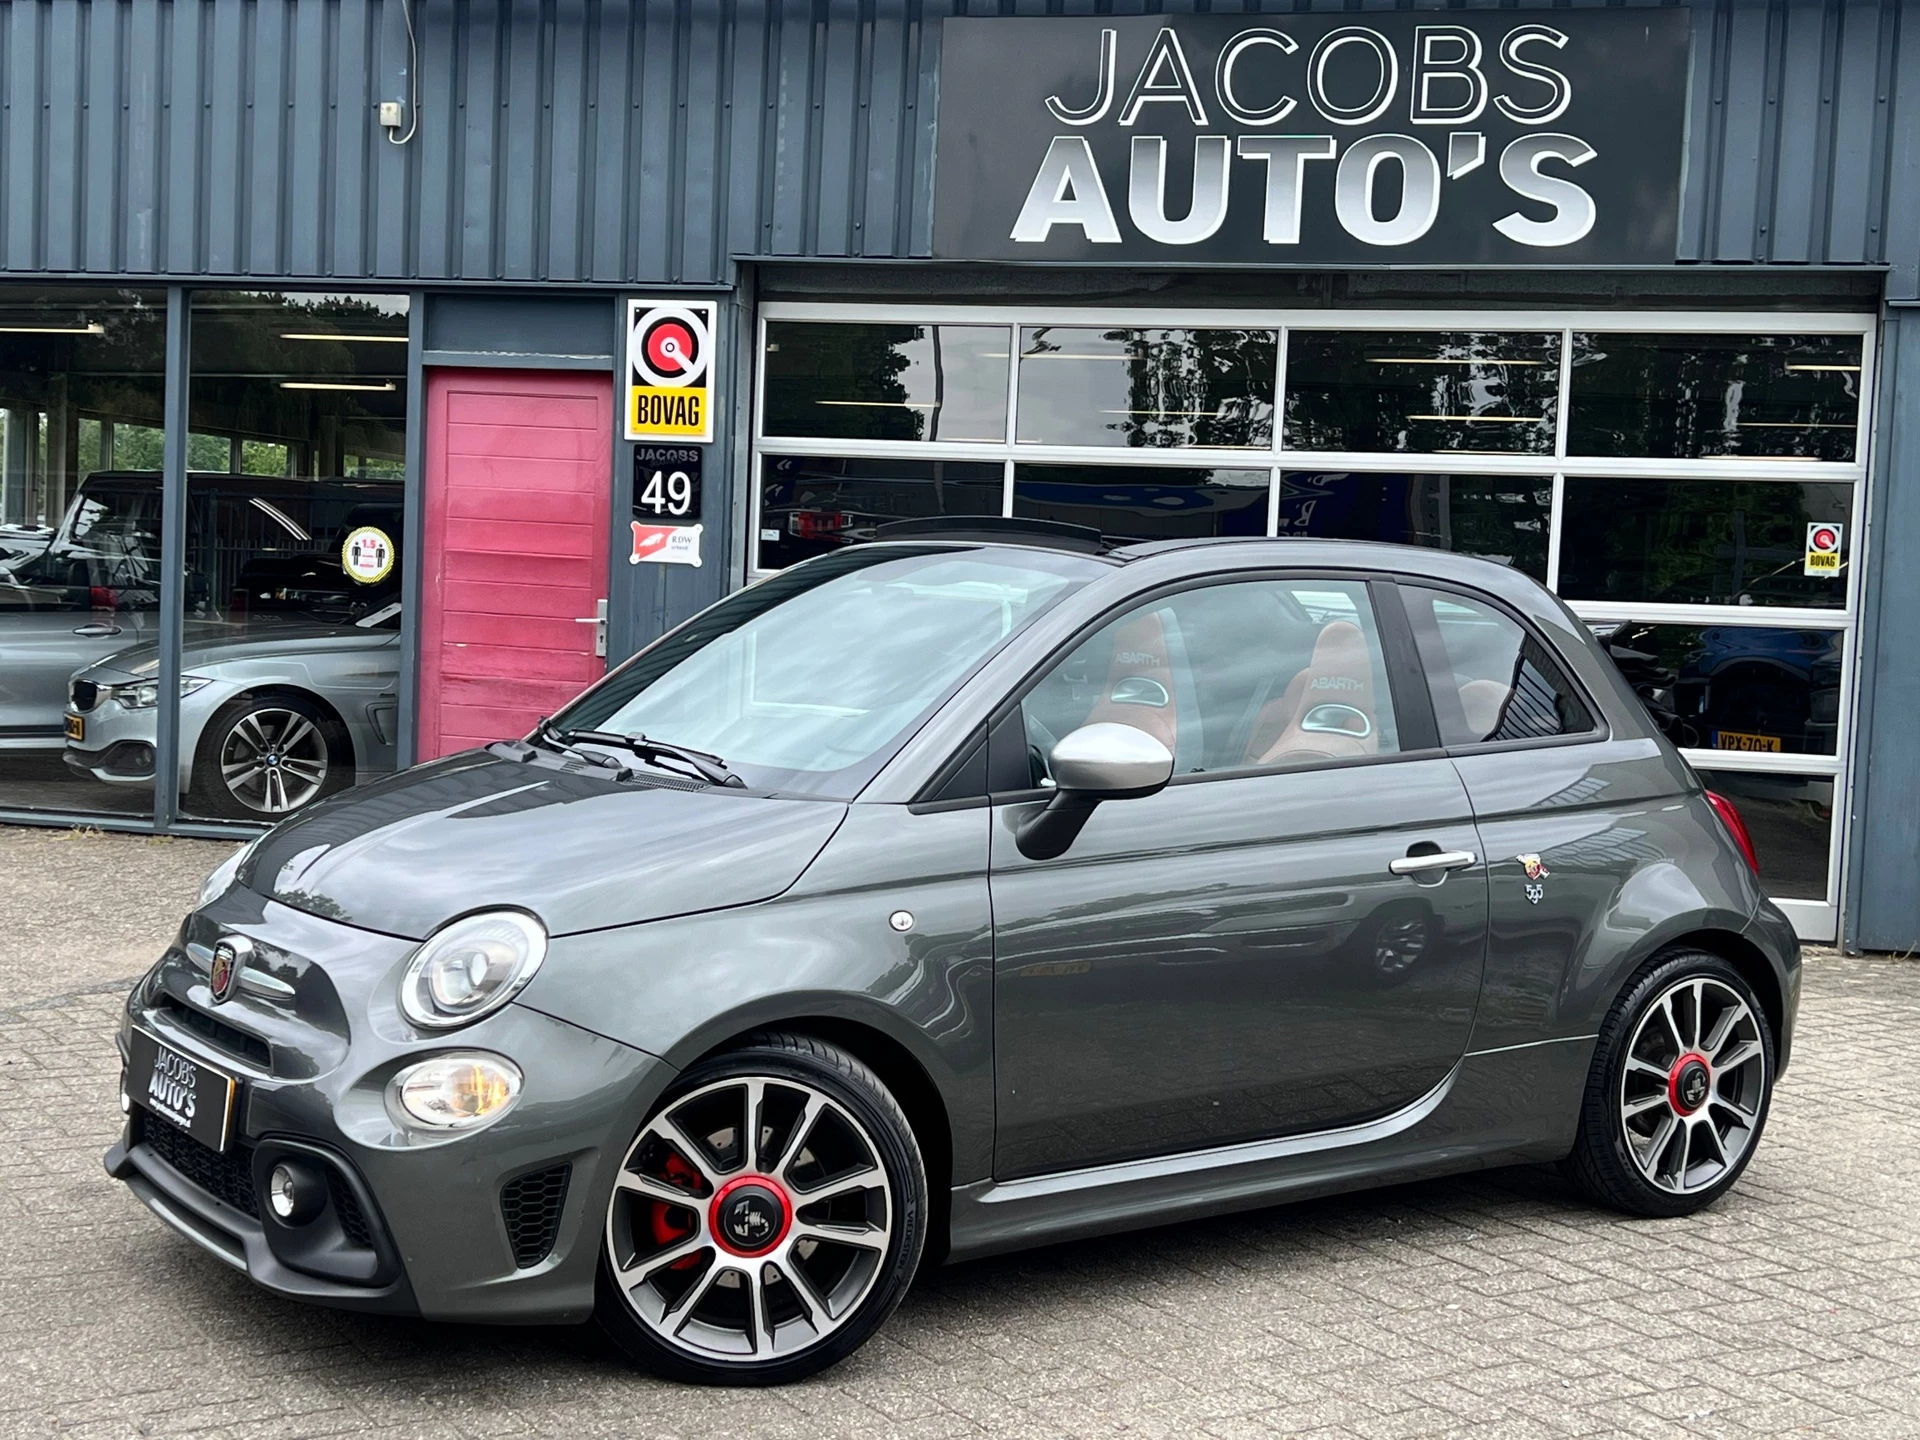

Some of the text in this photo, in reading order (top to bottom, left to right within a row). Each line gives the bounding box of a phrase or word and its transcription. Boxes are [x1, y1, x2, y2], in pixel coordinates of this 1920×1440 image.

[1045, 24, 1571, 127] JACOBS
[1010, 132, 1598, 247] AUTO'S
[637, 395, 700, 426] BOVAG
[636, 448, 699, 463] JACOBS
[641, 470, 691, 516] 49
[672, 535, 693, 544] RDW
[1810, 554, 1836, 567] BOVAG
[1114, 651, 1160, 667] ABARTH
[1310, 676, 1365, 693] ABARTH
[1524, 883, 1544, 905] 595
[154, 1046, 197, 1088] JACOBS
[148, 1068, 197, 1118] AUTO'S
